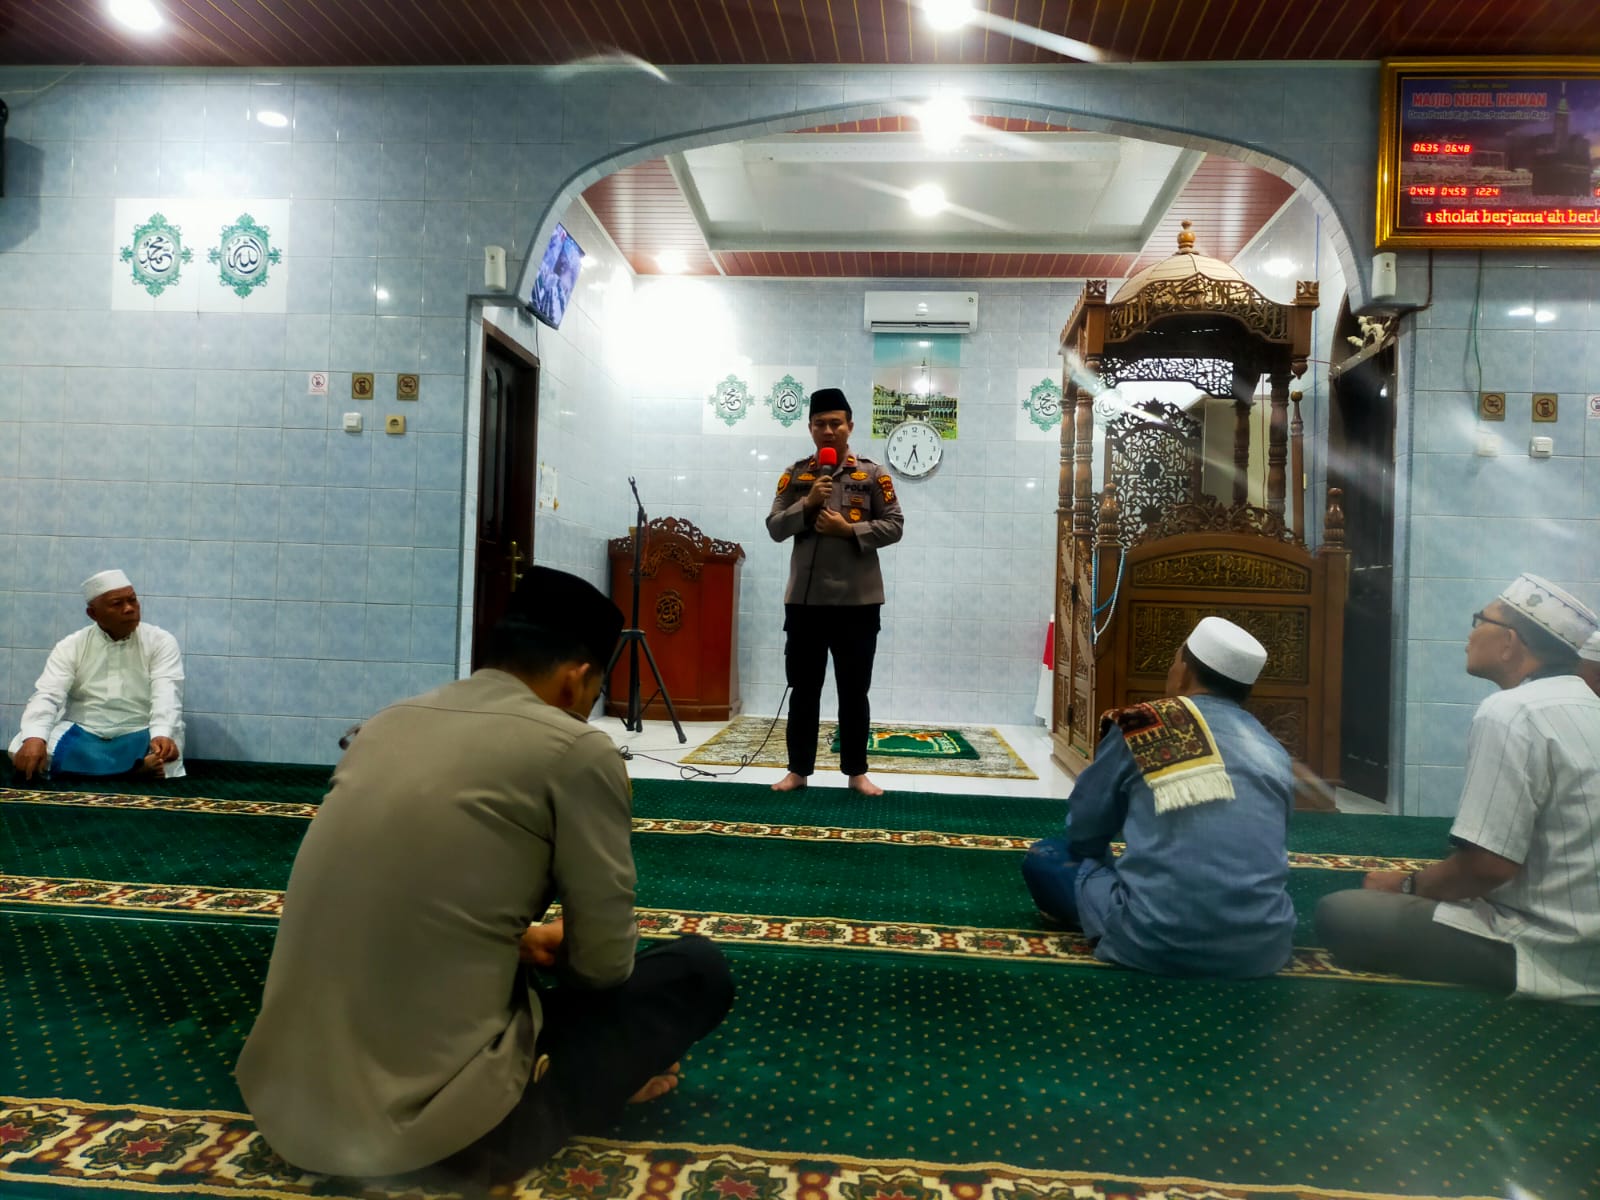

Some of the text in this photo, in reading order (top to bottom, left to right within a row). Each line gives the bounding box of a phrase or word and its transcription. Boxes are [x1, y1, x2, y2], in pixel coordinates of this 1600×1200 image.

[1435, 209, 1480, 223] sholat
[1482, 208, 1566, 226] berjama'ah
[1568, 209, 1600, 223] berl
